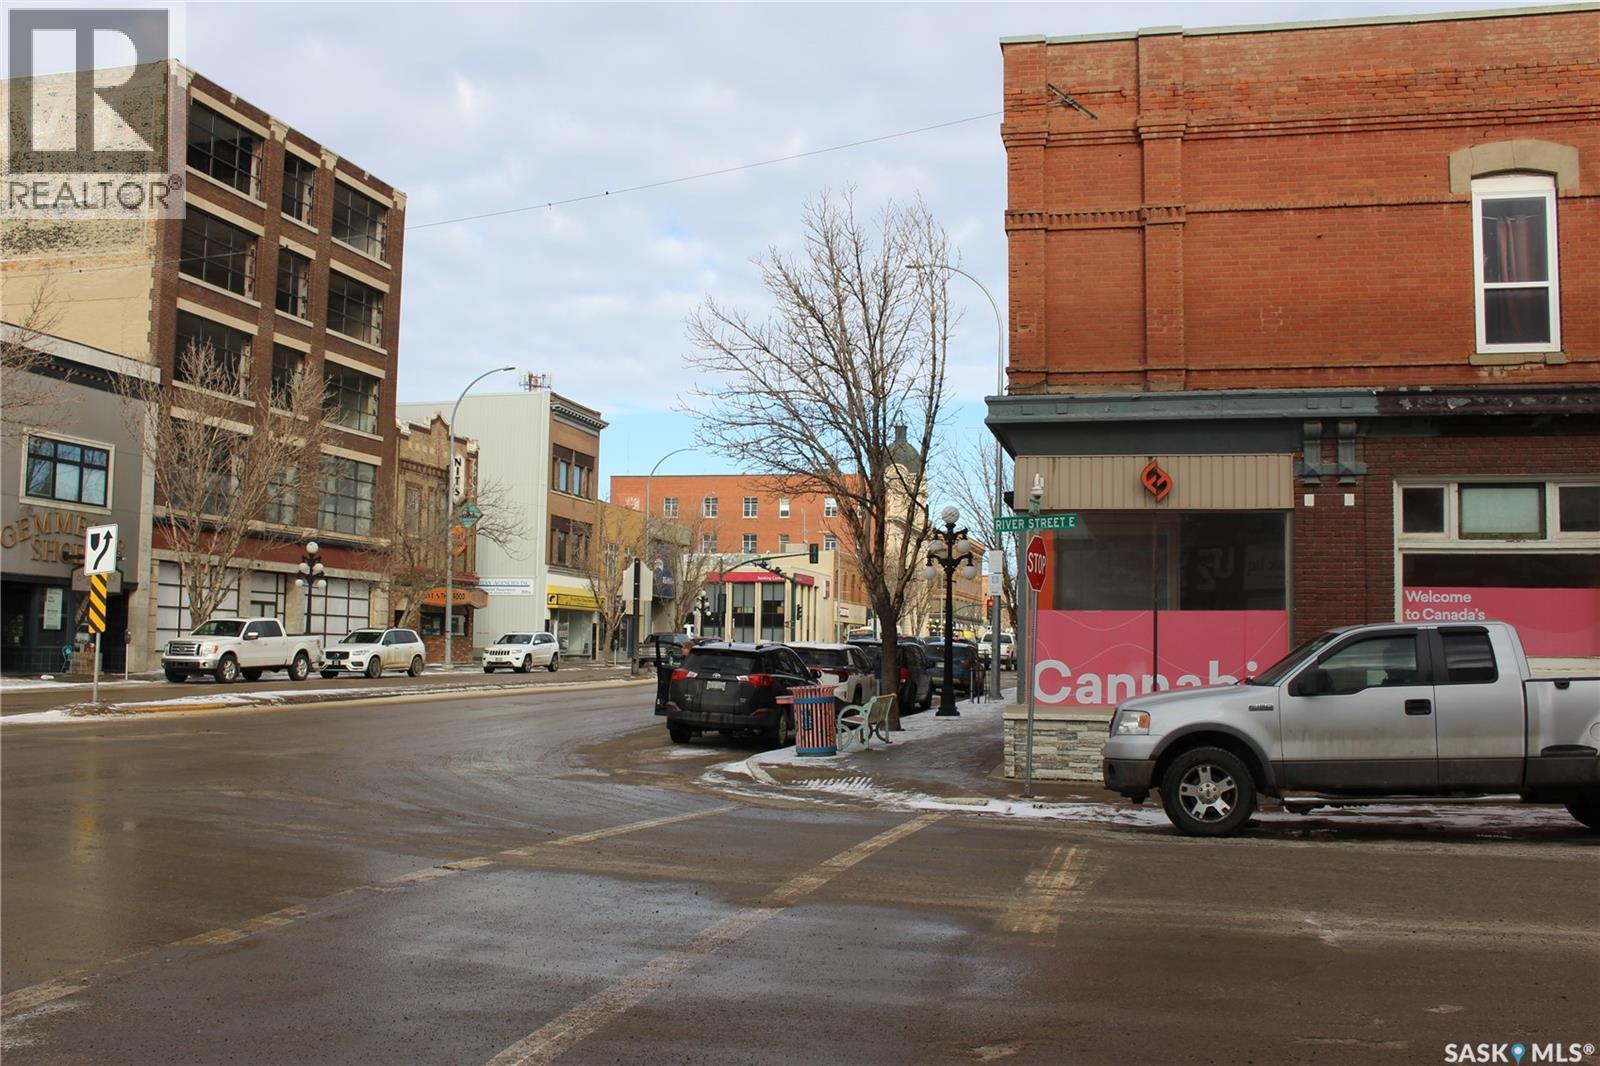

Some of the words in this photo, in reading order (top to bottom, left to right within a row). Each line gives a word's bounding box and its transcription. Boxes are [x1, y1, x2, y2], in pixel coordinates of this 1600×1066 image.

[995, 519, 1025, 530] RIVER
[1028, 516, 1066, 529] STREET
[1068, 516, 1076, 528] E
[1027, 552, 1046, 575] STOP
[1405, 590, 1472, 603] Welcome
[1405, 608, 1420, 620] to
[1422, 608, 1486, 620] Canada's
